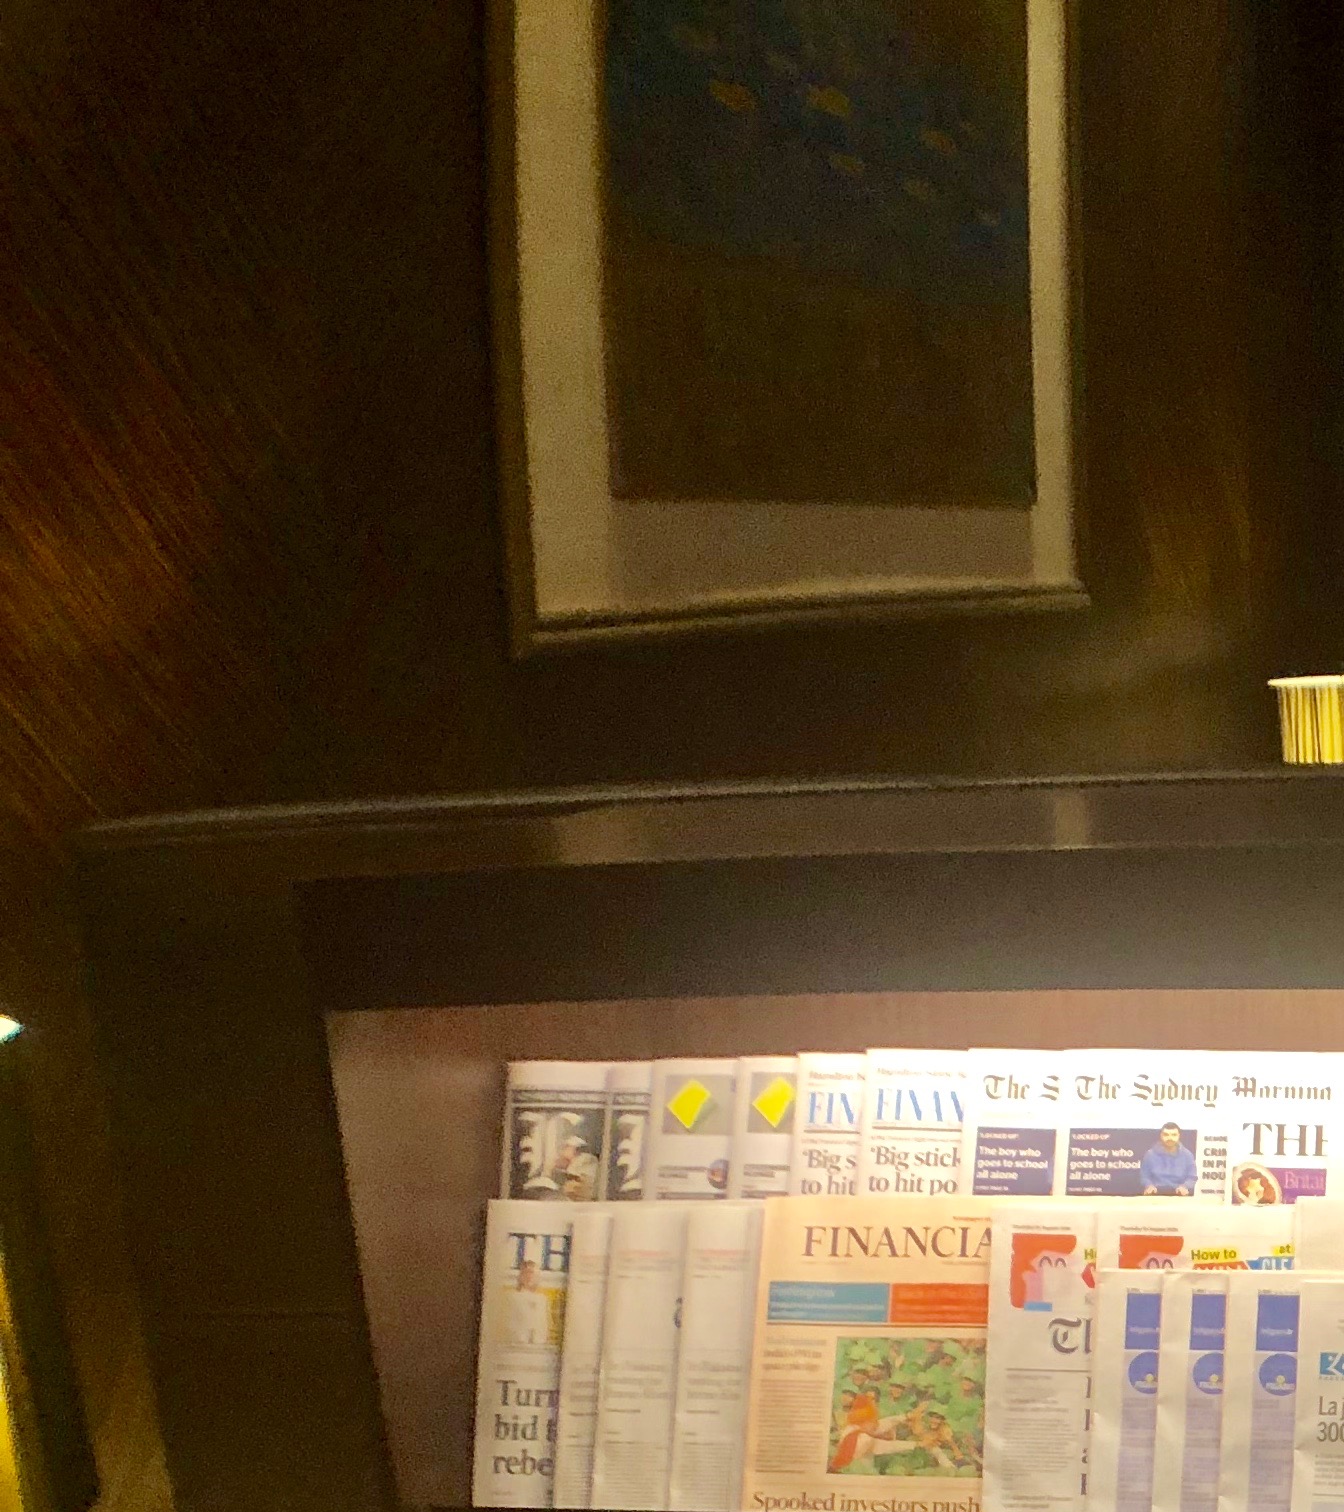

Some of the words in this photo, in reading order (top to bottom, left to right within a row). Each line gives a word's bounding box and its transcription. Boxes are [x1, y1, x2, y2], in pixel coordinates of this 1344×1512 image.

[983, 1074, 1030, 1101] The
[1075, 1074, 1121, 1101] The
[1131, 1074, 1219, 1107] Sydney
[1070, 1147, 1090, 1157] The
[1091, 1147, 1109, 1158] boy
[1111, 1148, 1134, 1158] who
[1014, 1159, 1049, 1170] school
[1069, 1161, 1094, 1172] goes
[1095, 1160, 1106, 1170] to
[1107, 1160, 1141, 1171] school
[868, 1175, 890, 1193] to
[894, 1171, 924, 1193] hit
[1069, 1171, 1081, 1181] all
[1082, 1172, 1111, 1182] alone
[1190, 1249, 1221, 1262] How
[1222, 1248, 1238, 1260] to
[1278, 1244, 1292, 1255] at
[1318, 1396, 1338, 1417] La
[494, 1413, 538, 1441] bid
